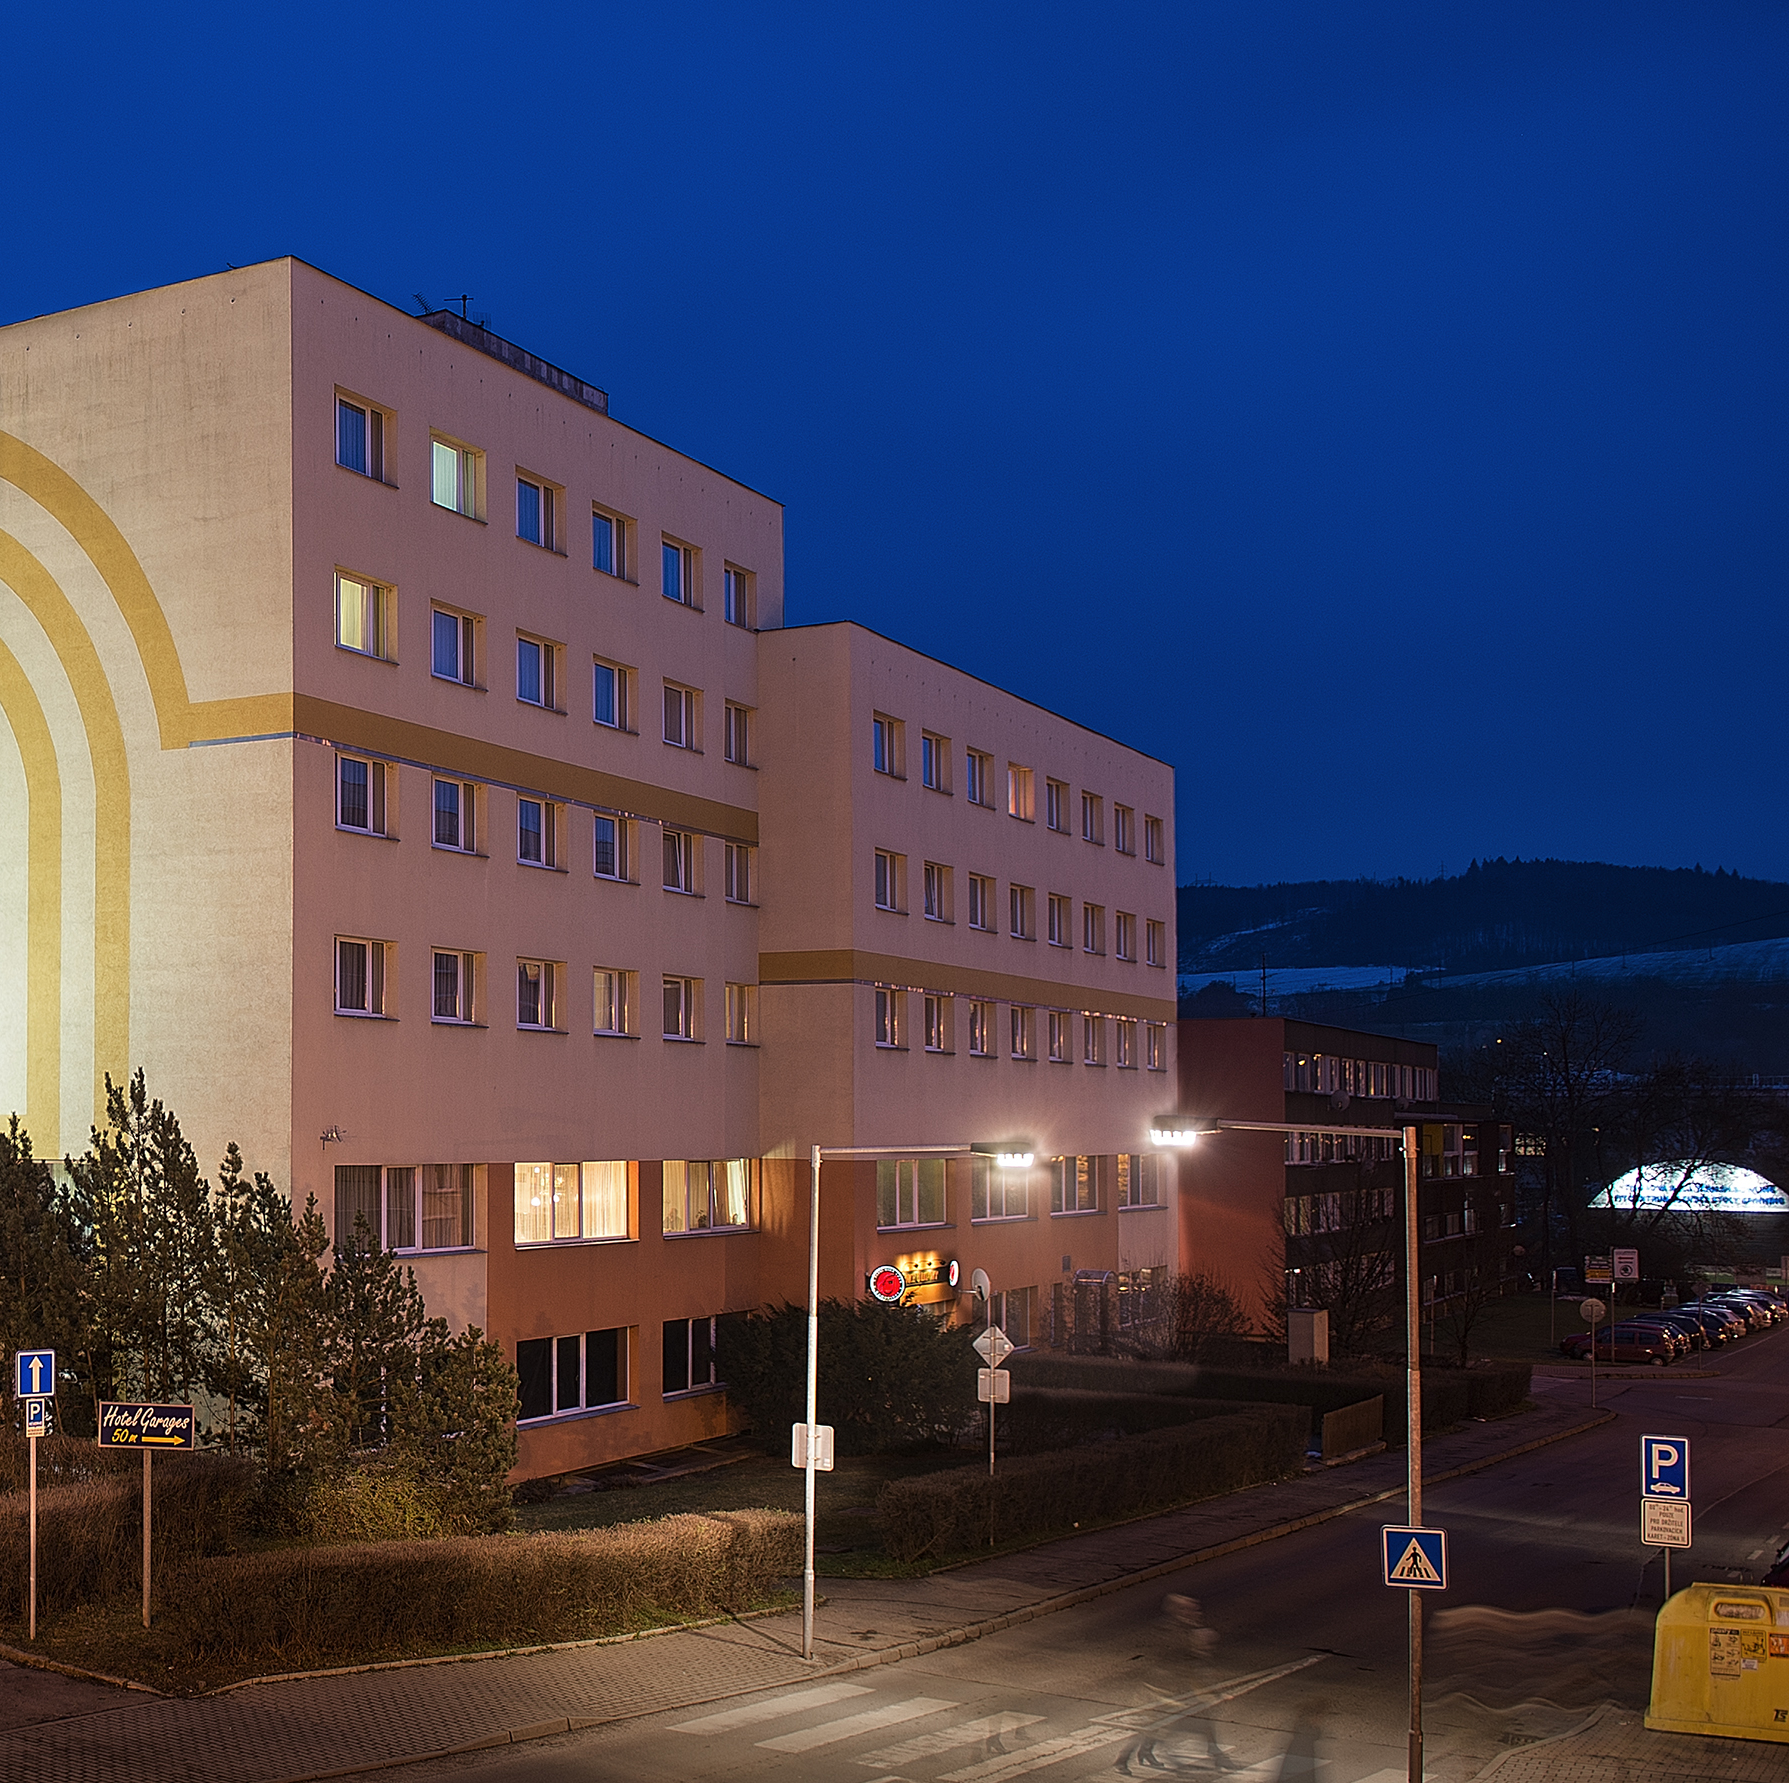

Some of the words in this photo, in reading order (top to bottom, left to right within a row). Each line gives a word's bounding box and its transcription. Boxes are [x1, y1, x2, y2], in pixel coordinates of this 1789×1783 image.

[103, 1405, 143, 1427] Hotel
[140, 1407, 190, 1436] Garages
[111, 1428, 129, 1443] 50
[1651, 1443, 1679, 1479] P
